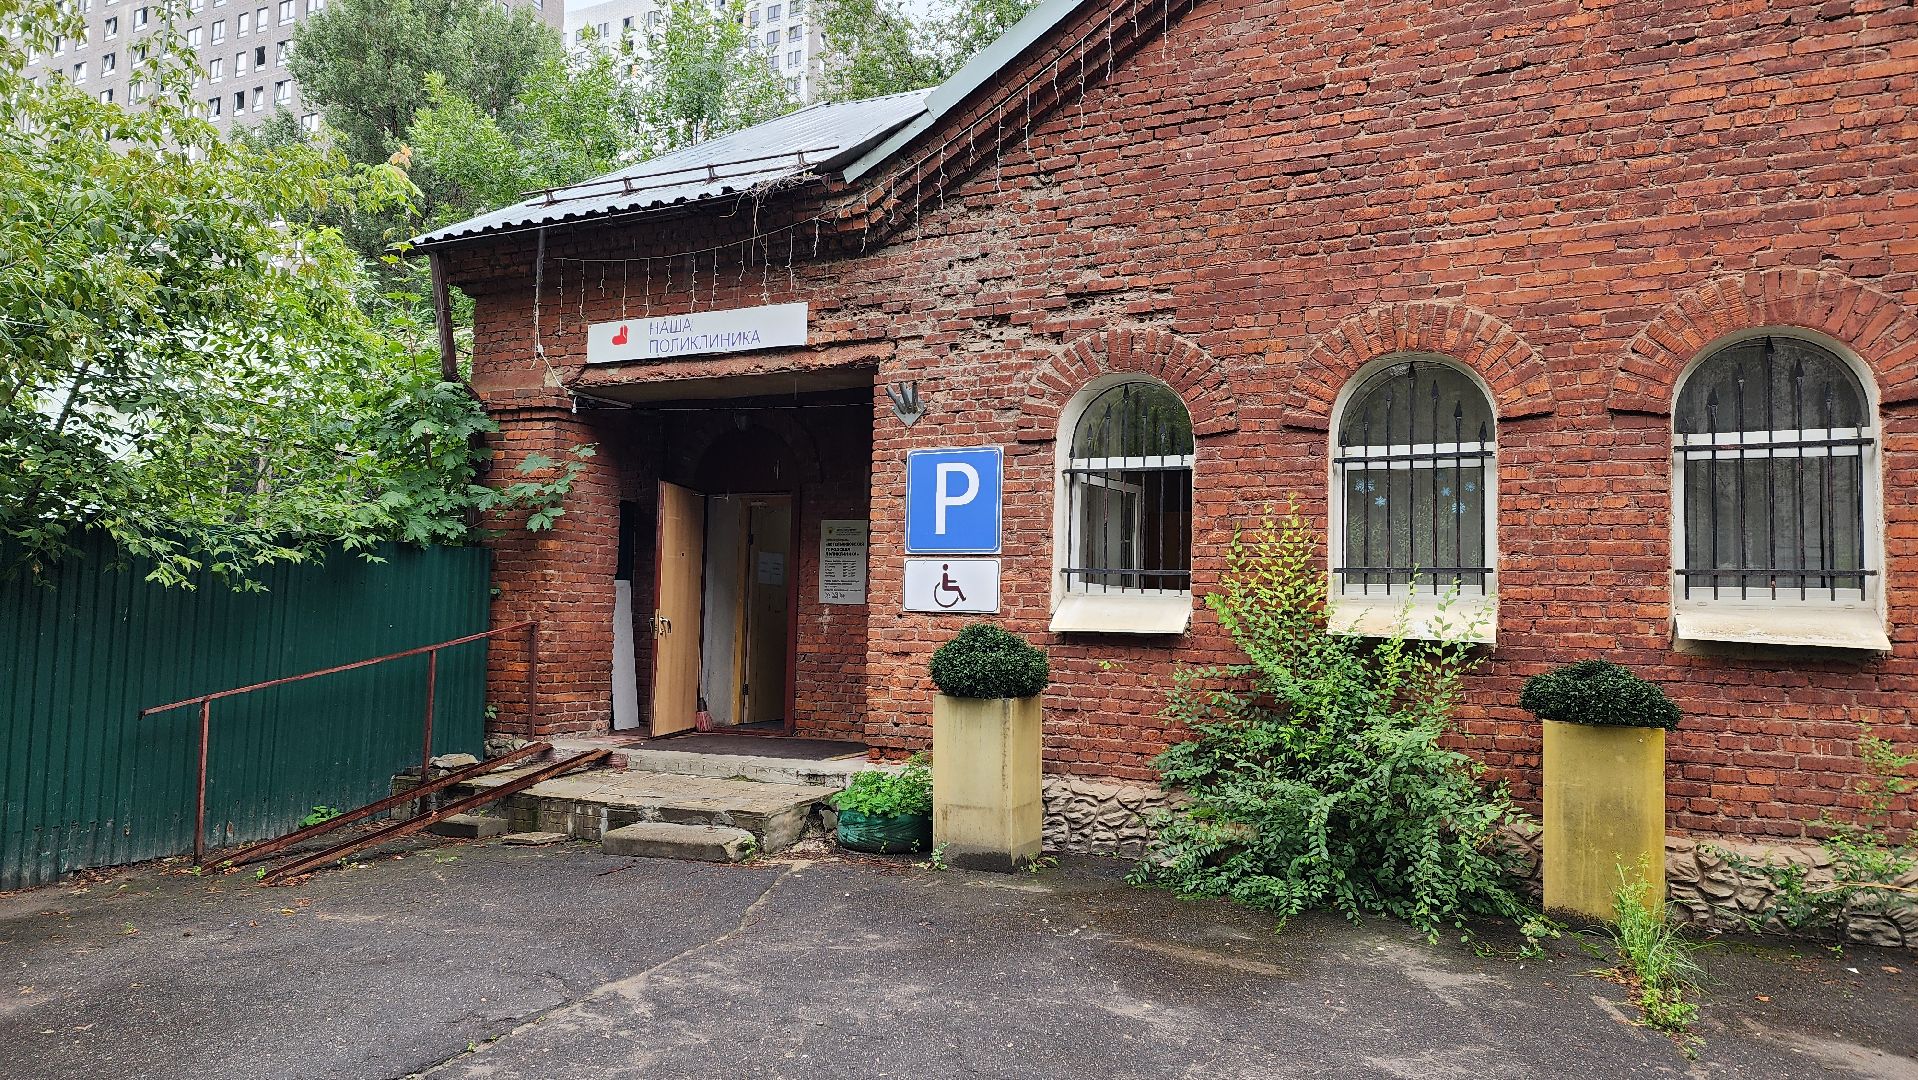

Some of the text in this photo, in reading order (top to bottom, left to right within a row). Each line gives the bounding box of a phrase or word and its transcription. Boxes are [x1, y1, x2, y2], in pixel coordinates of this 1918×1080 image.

[649, 317, 692, 336] НАША
[649, 329, 760, 354] ПОЛИКЛИНИКА
[935, 462, 980, 535] P
